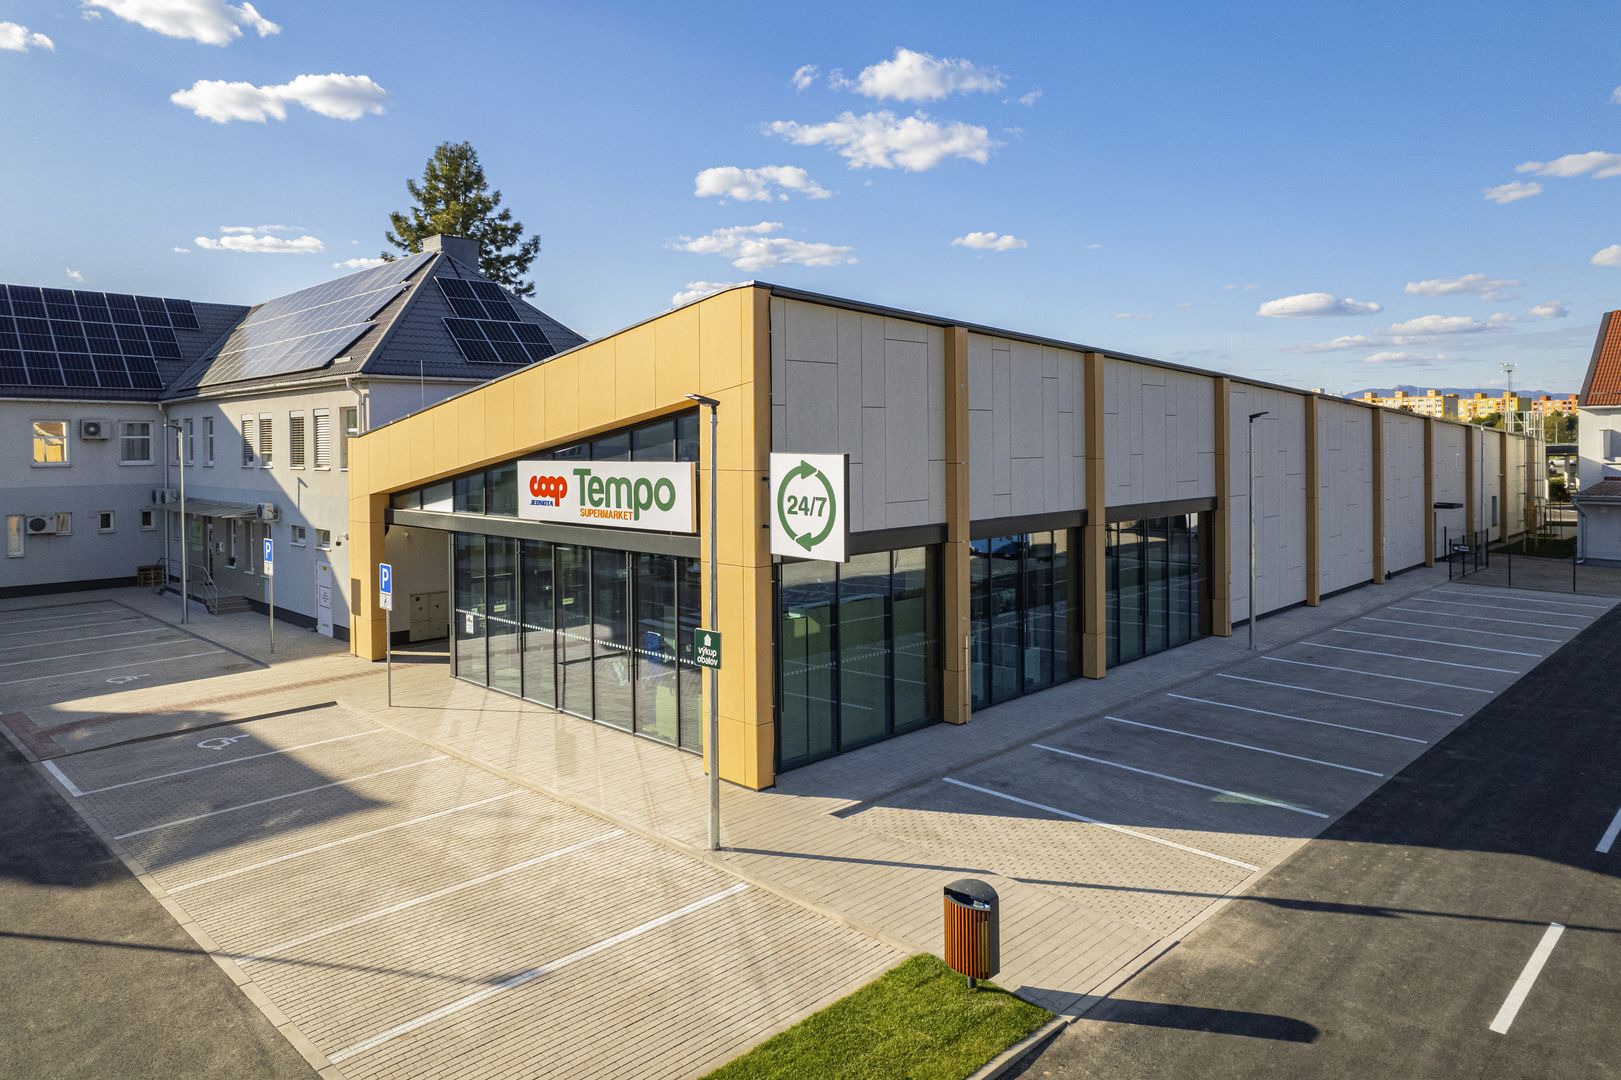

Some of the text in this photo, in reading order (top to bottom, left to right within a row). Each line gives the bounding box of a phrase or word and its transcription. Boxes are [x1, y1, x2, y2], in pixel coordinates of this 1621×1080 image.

[529, 468, 676, 521] coop Tempo
[580, 508, 633, 521] SUPERMARKET
[787, 495, 828, 517] 24/7
[265, 541, 271, 559] P
[382, 567, 389, 589] P
[697, 646, 717, 658] výkup
[697, 655, 718, 666] obalov
